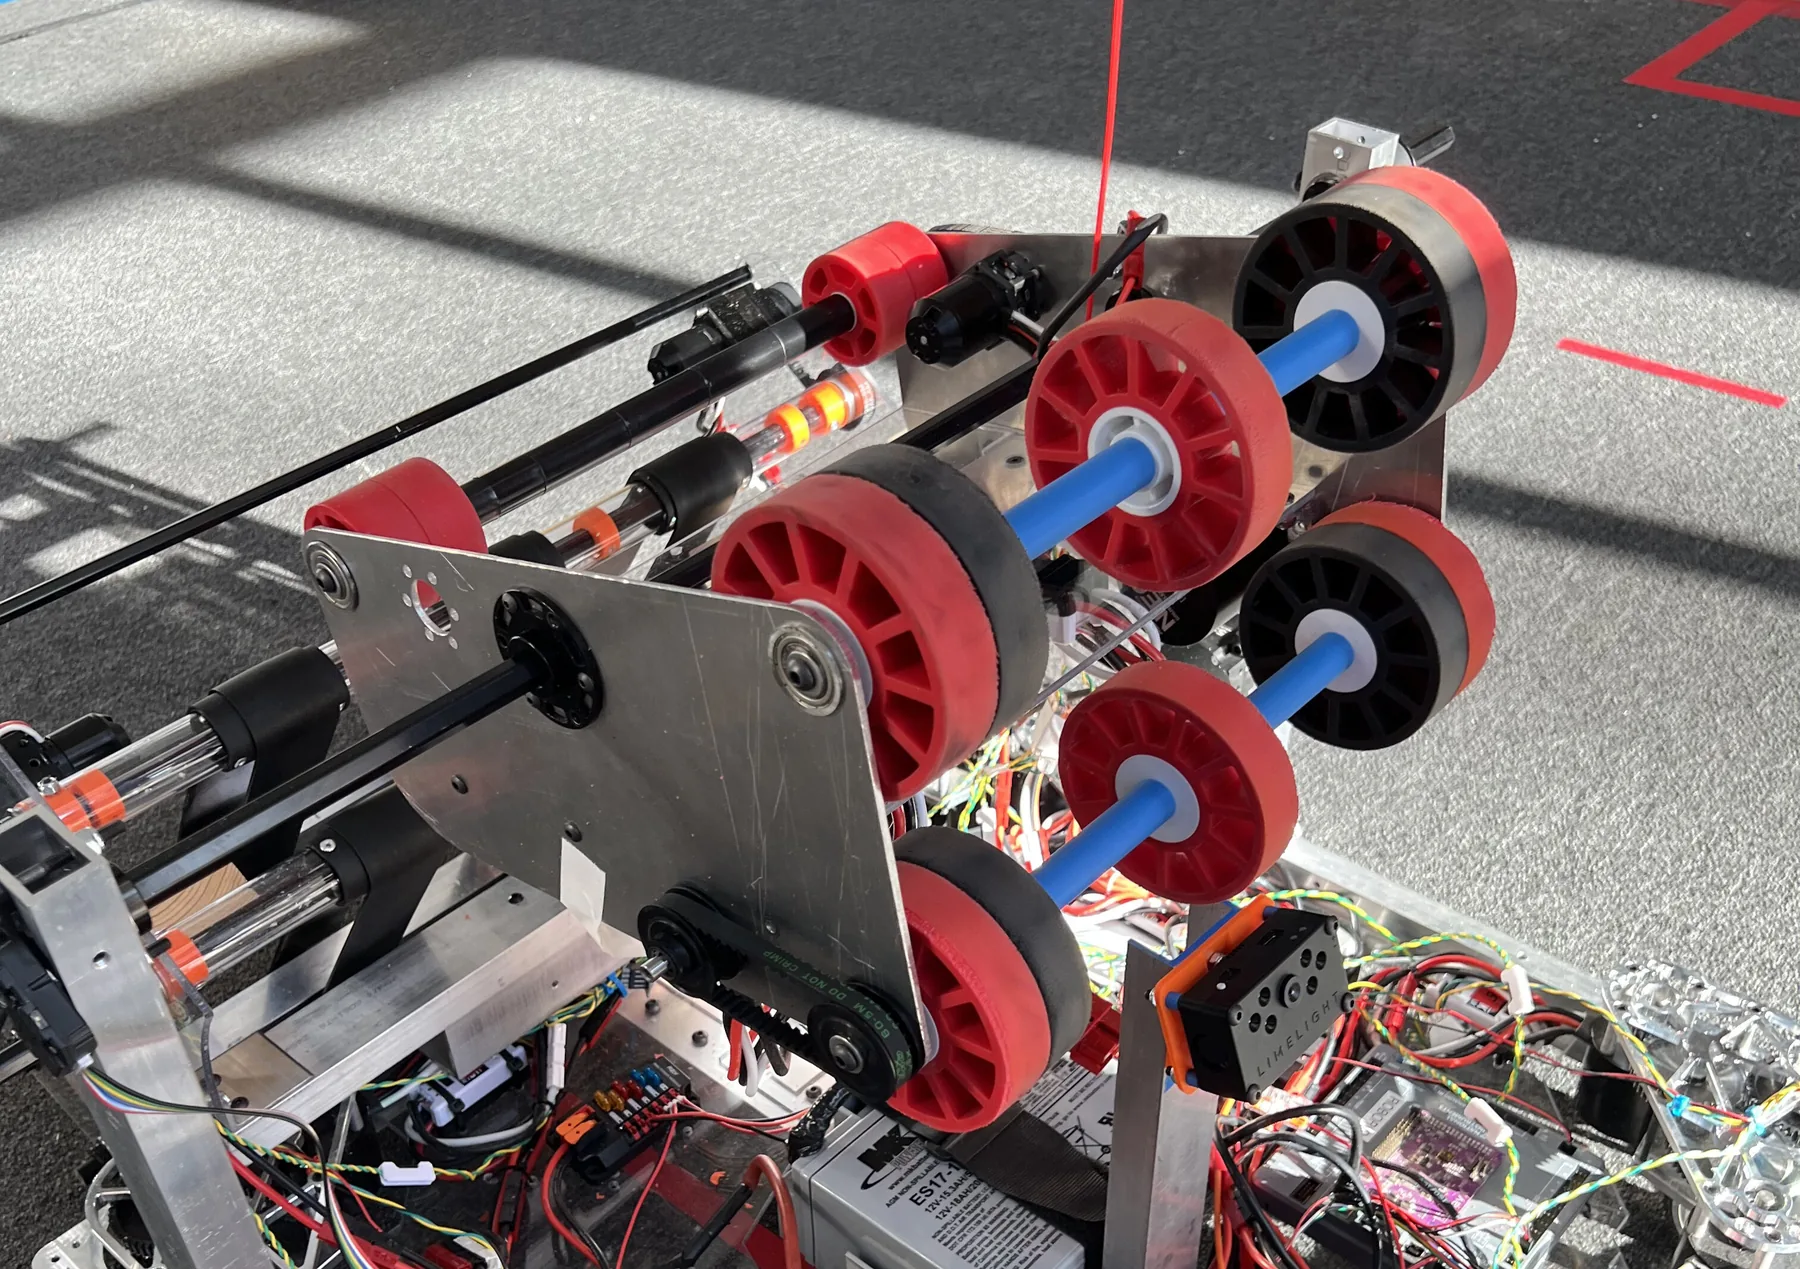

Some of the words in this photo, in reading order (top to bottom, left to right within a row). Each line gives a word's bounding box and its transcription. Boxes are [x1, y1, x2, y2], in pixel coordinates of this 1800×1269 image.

[762, 949, 799, 972] CRIMP
[801, 973, 828, 989] NOT
[828, 987, 848, 1001] DO
[1256, 990, 1339, 1077] LIMELIGHT
[857, 1123, 920, 1173] MK
[885, 1195, 900, 1208] AGM
[898, 1159, 941, 1197] NON-SPILLABLE
[908, 1161, 961, 1207] ES17-1
